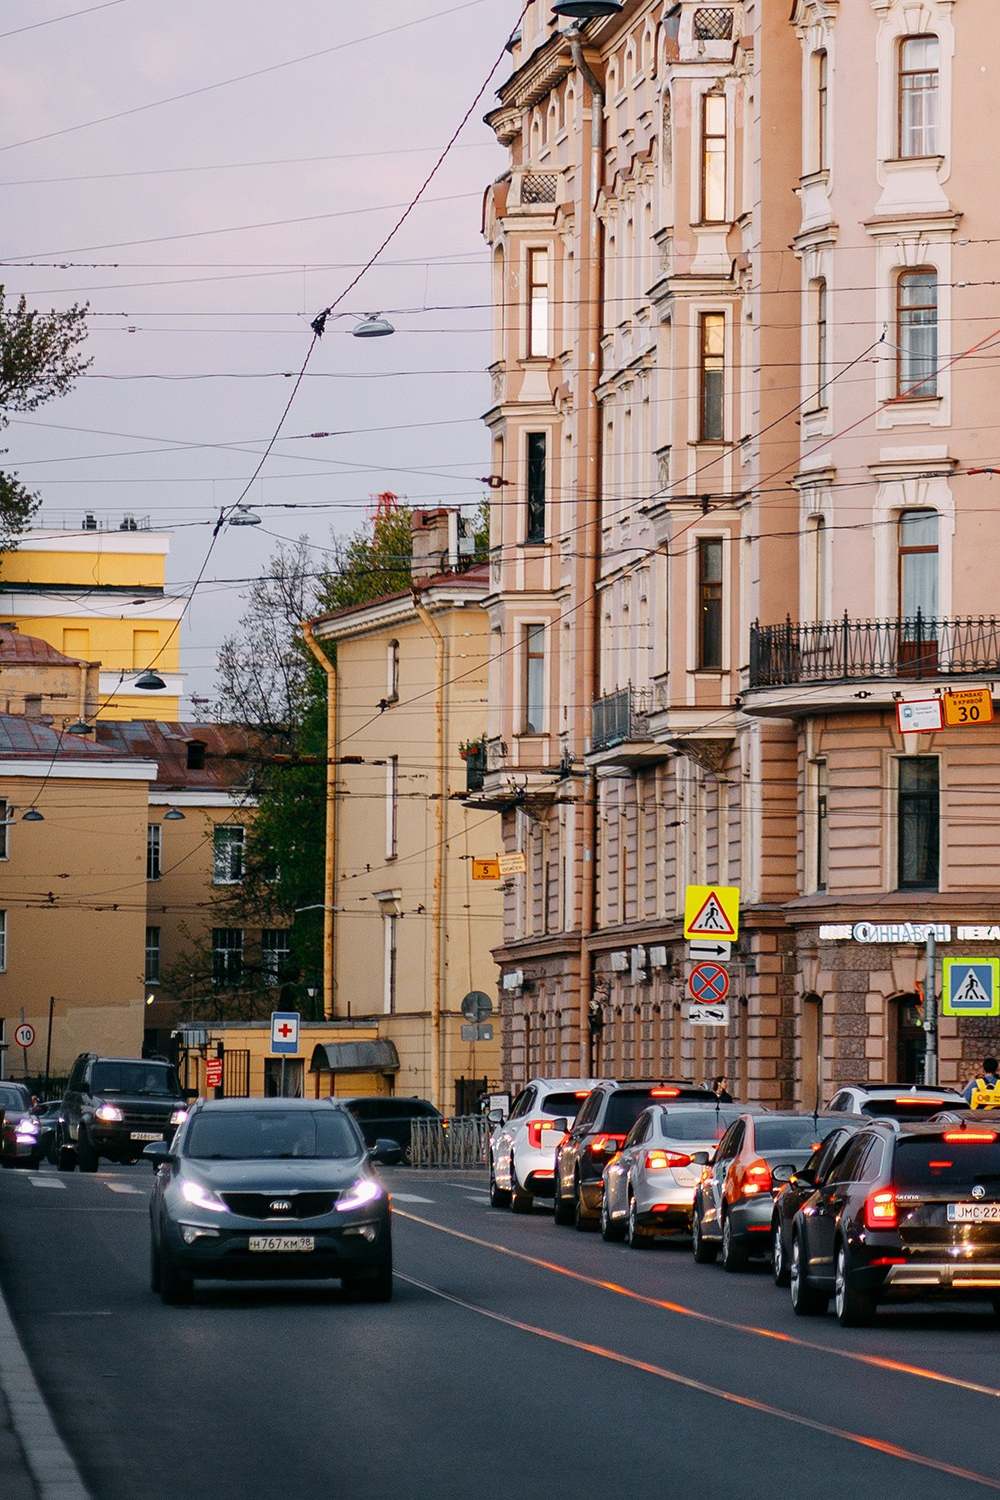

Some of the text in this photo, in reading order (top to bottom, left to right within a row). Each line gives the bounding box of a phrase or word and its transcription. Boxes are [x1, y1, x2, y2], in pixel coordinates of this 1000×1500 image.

[957, 705, 980, 722] 30
[483, 866, 489, 874] 5
[20, 1030, 32, 1041] 10
[299, 1238, 311, 1246] 98
